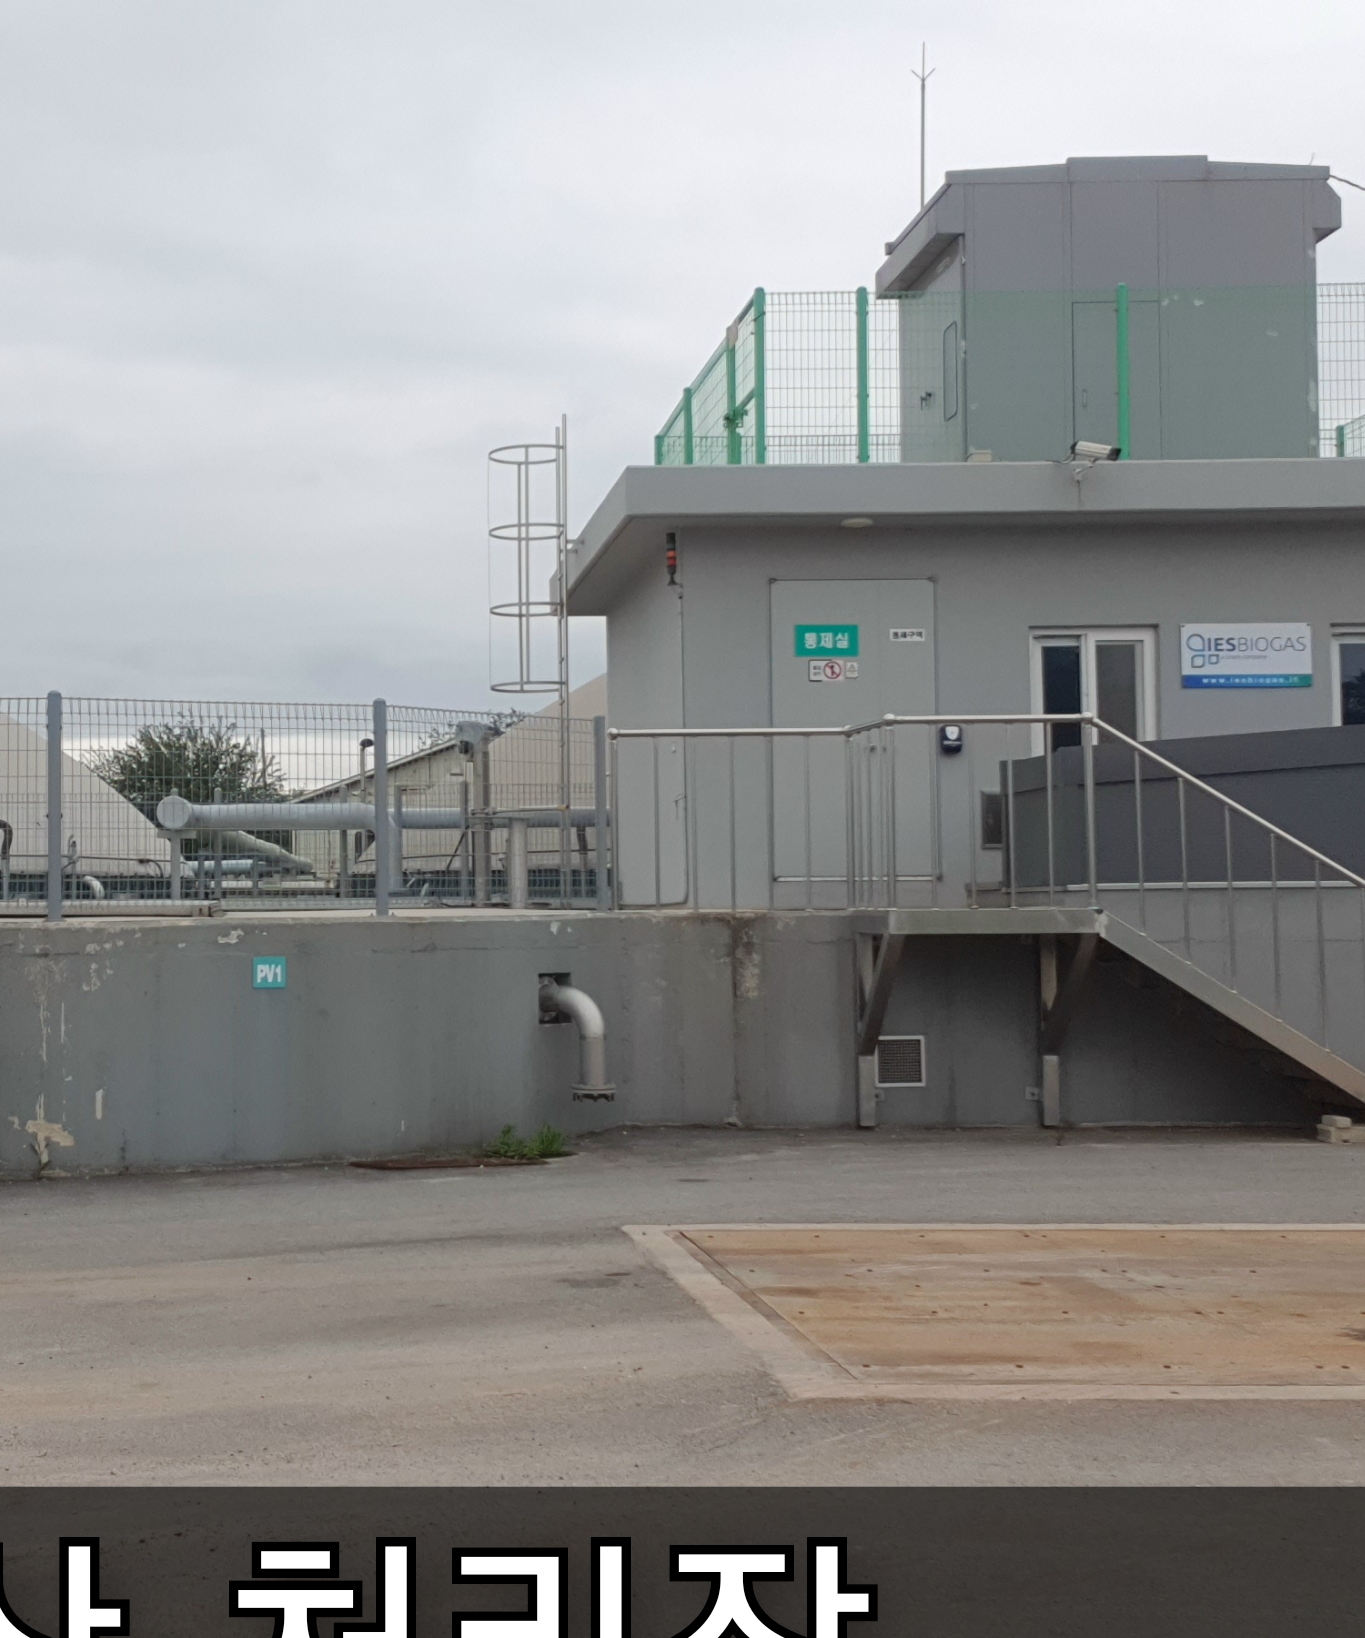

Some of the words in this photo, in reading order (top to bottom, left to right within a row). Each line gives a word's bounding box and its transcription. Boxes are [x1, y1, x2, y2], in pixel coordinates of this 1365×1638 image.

[804, 632, 849, 649] 통제실
[1207, 636, 1307, 652] IESBIOGAS
[257, 964, 282, 983] PV1
